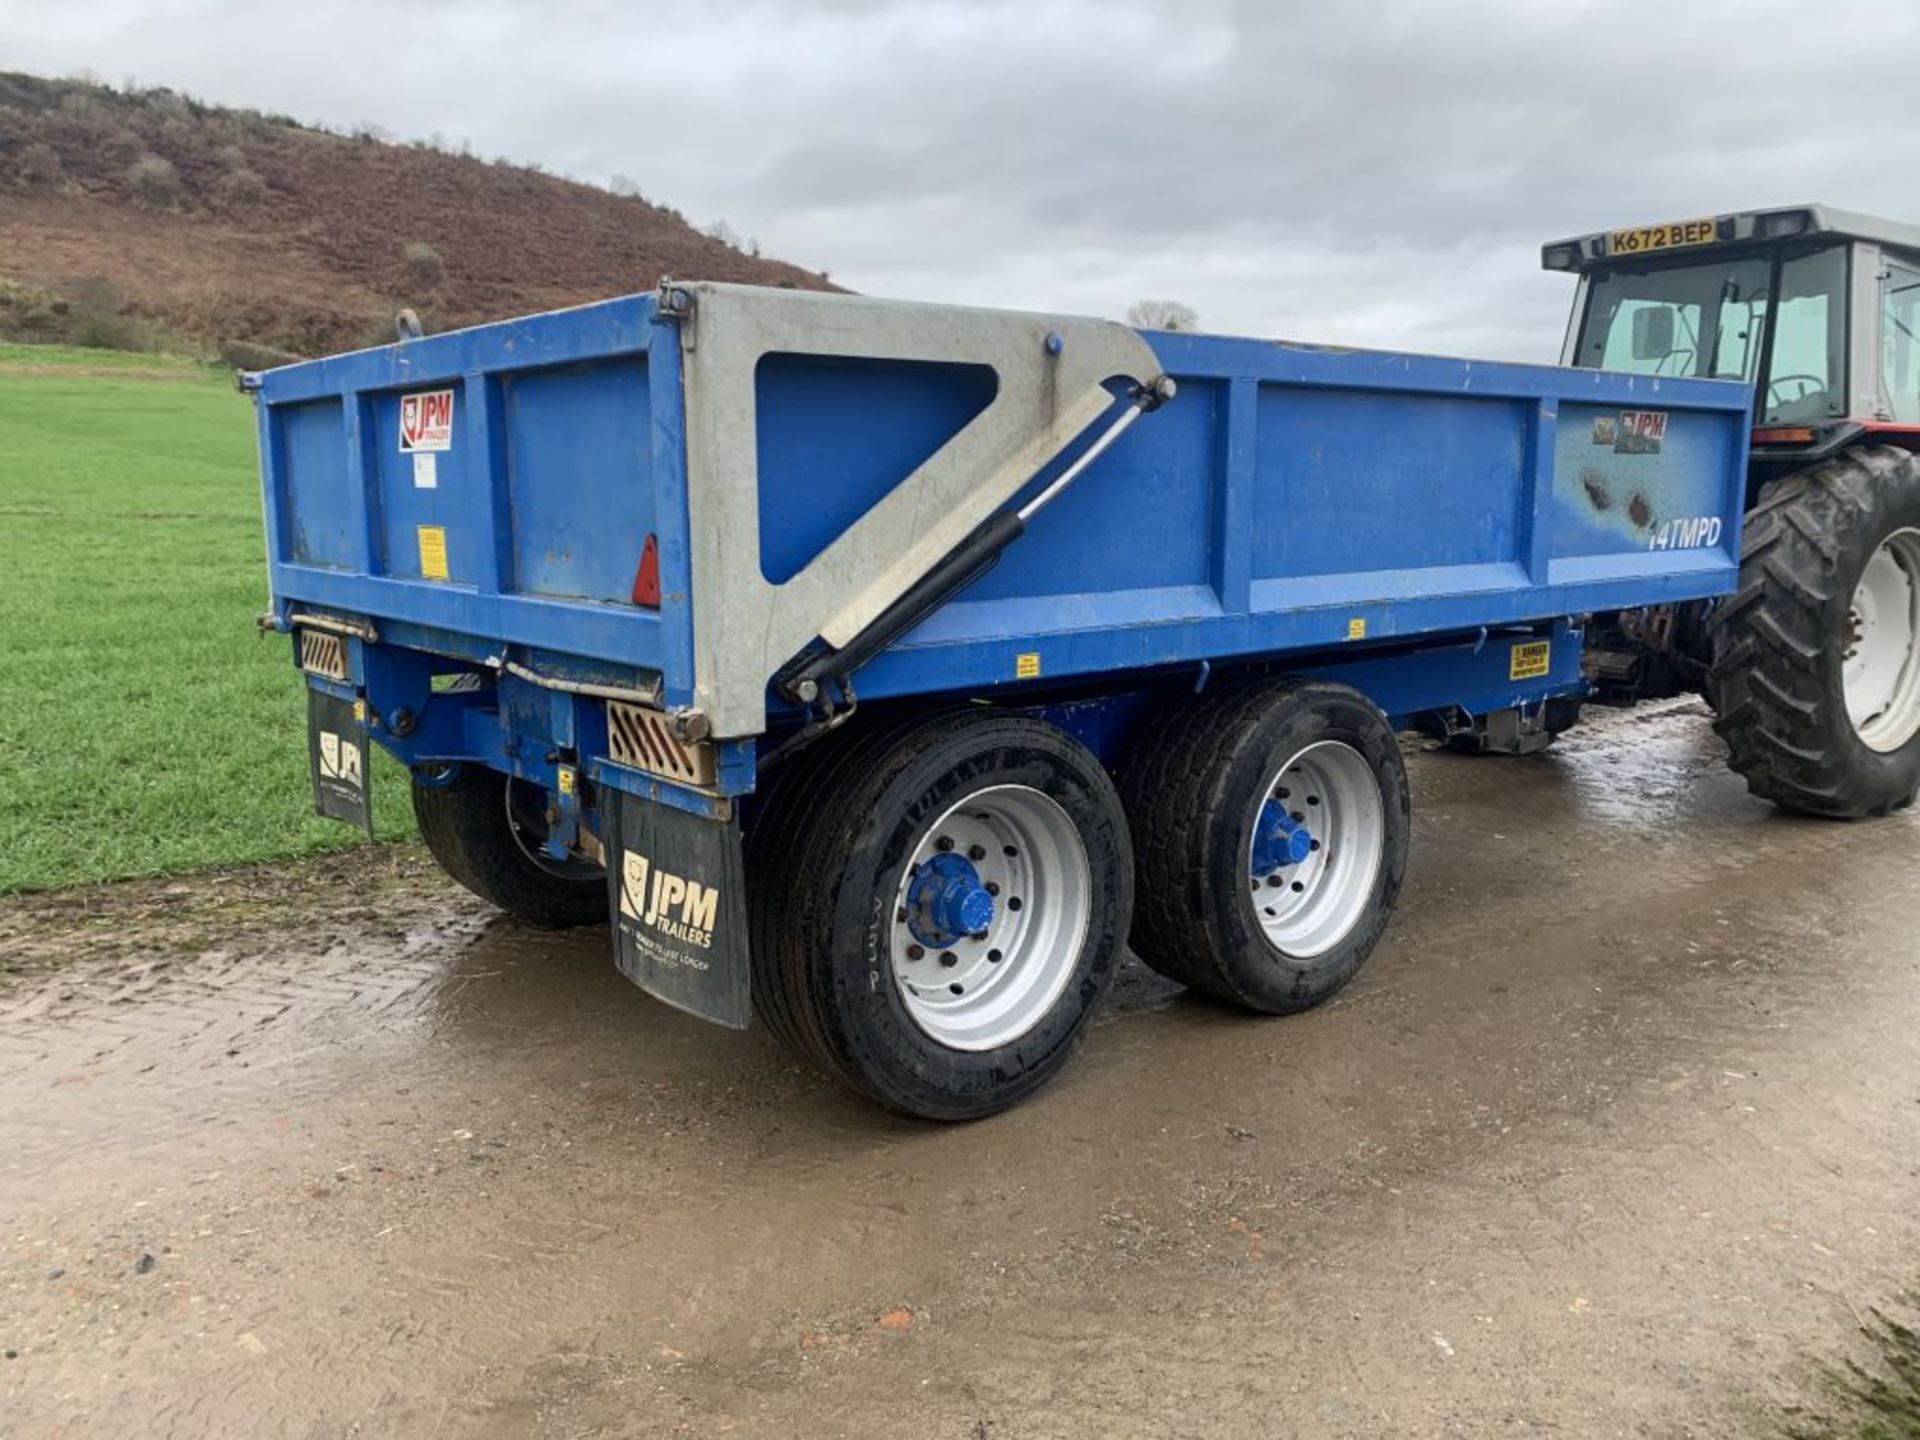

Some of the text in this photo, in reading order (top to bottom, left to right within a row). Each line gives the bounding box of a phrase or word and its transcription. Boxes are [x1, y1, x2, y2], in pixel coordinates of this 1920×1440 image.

[1614, 222, 1713, 252] K672 BEP
[417, 393, 451, 441] JPM
[643, 869, 720, 933] JPM
[656, 915, 712, 949] TRAILERS
